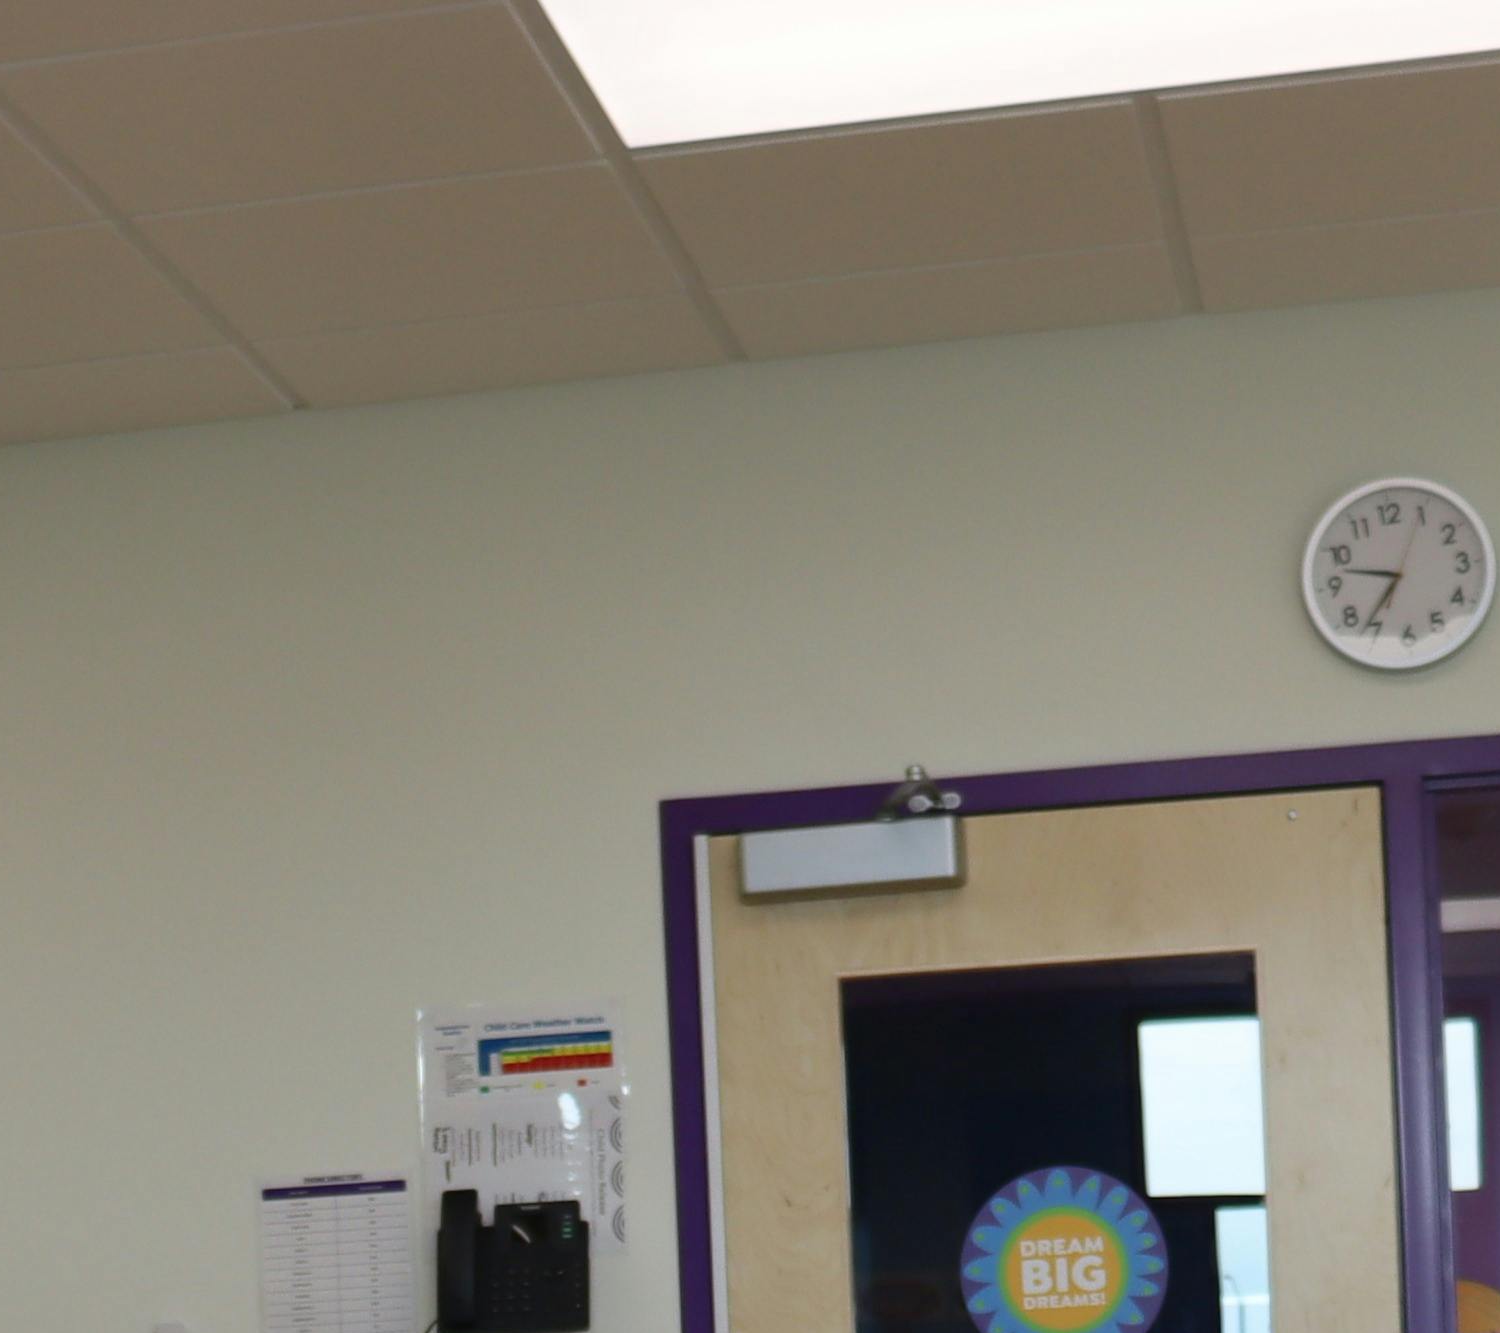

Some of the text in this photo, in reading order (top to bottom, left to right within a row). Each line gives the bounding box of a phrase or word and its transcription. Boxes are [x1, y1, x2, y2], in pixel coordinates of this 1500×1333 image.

[1377, 503, 1400, 525] 12
[1417, 506, 1426, 525] 1
[1351, 518, 1370, 540] 11
[1441, 524, 1456, 545] 2
[1330, 545, 1350, 565] 10
[1456, 552, 1470, 574] 3
[1328, 576, 1342, 598] 9
[1451, 587, 1464, 605] 4
[1343, 606, 1359, 627] 8
[1430, 612, 1444, 632] 5
[1020, 1236, 1104, 1257] DREAM
[1021, 1255, 1107, 1296] BIG
[1023, 1292, 1106, 1311] DREAMS!
